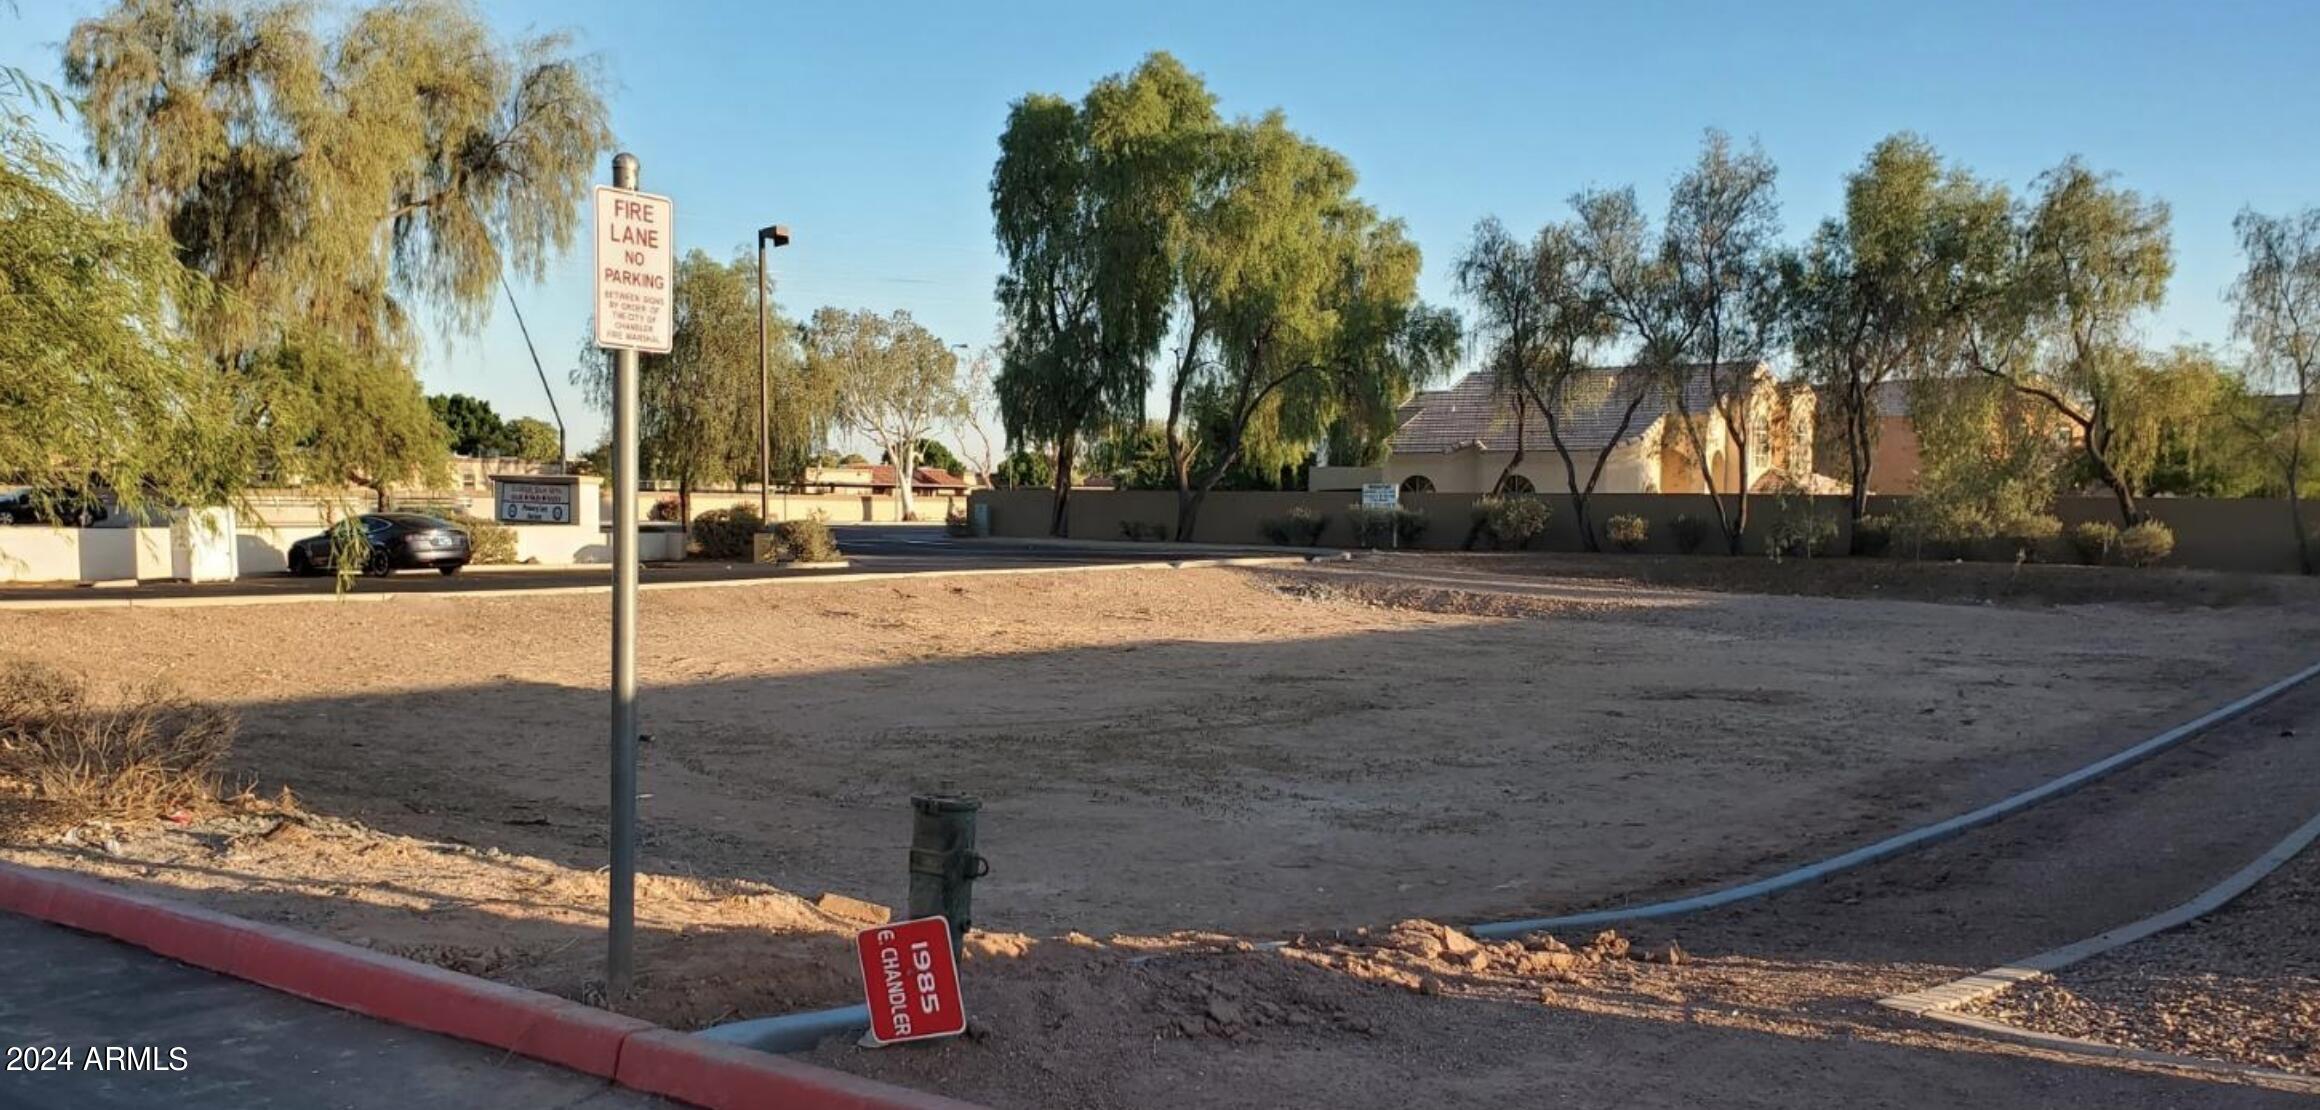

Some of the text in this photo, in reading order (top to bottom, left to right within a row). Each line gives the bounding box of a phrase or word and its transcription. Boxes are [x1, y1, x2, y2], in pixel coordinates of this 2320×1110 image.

[614, 199, 654, 224] FIRE
[610, 222, 659, 249] LANE
[625, 250, 645, 267] NO
[604, 267, 664, 290] PARKING
[911, 941, 940, 1014] 1985
[881, 947, 911, 1036] CHANDLER
